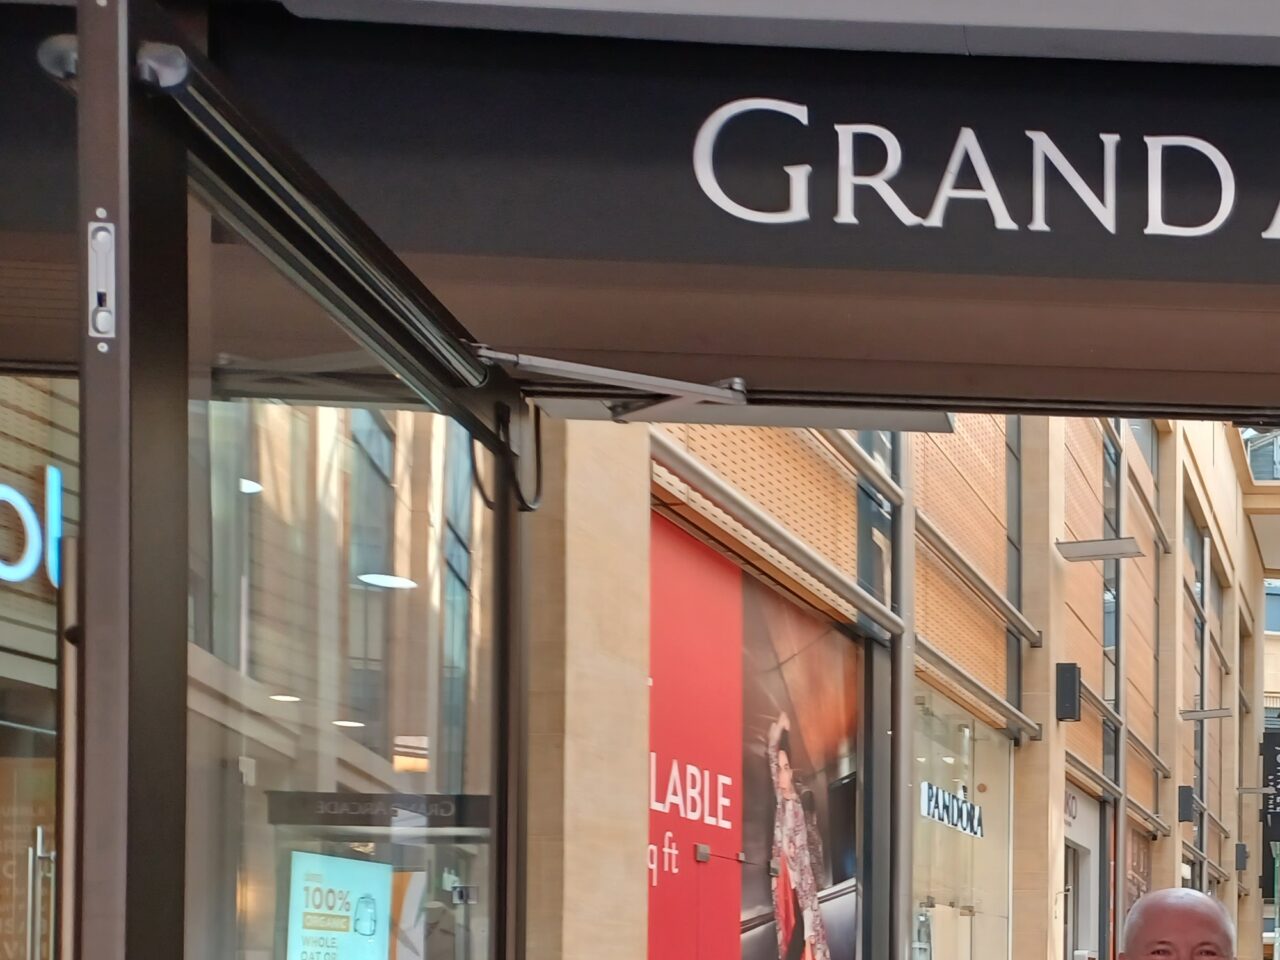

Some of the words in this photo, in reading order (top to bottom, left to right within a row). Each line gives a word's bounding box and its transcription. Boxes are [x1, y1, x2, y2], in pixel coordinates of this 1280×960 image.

[692, 97, 1236, 236] GRAND
[650, 751, 733, 830] LABLE
[923, 782, 984, 838] PANDORA
[662, 831, 679, 874] ft
[303, 886, 351, 912] 100%
